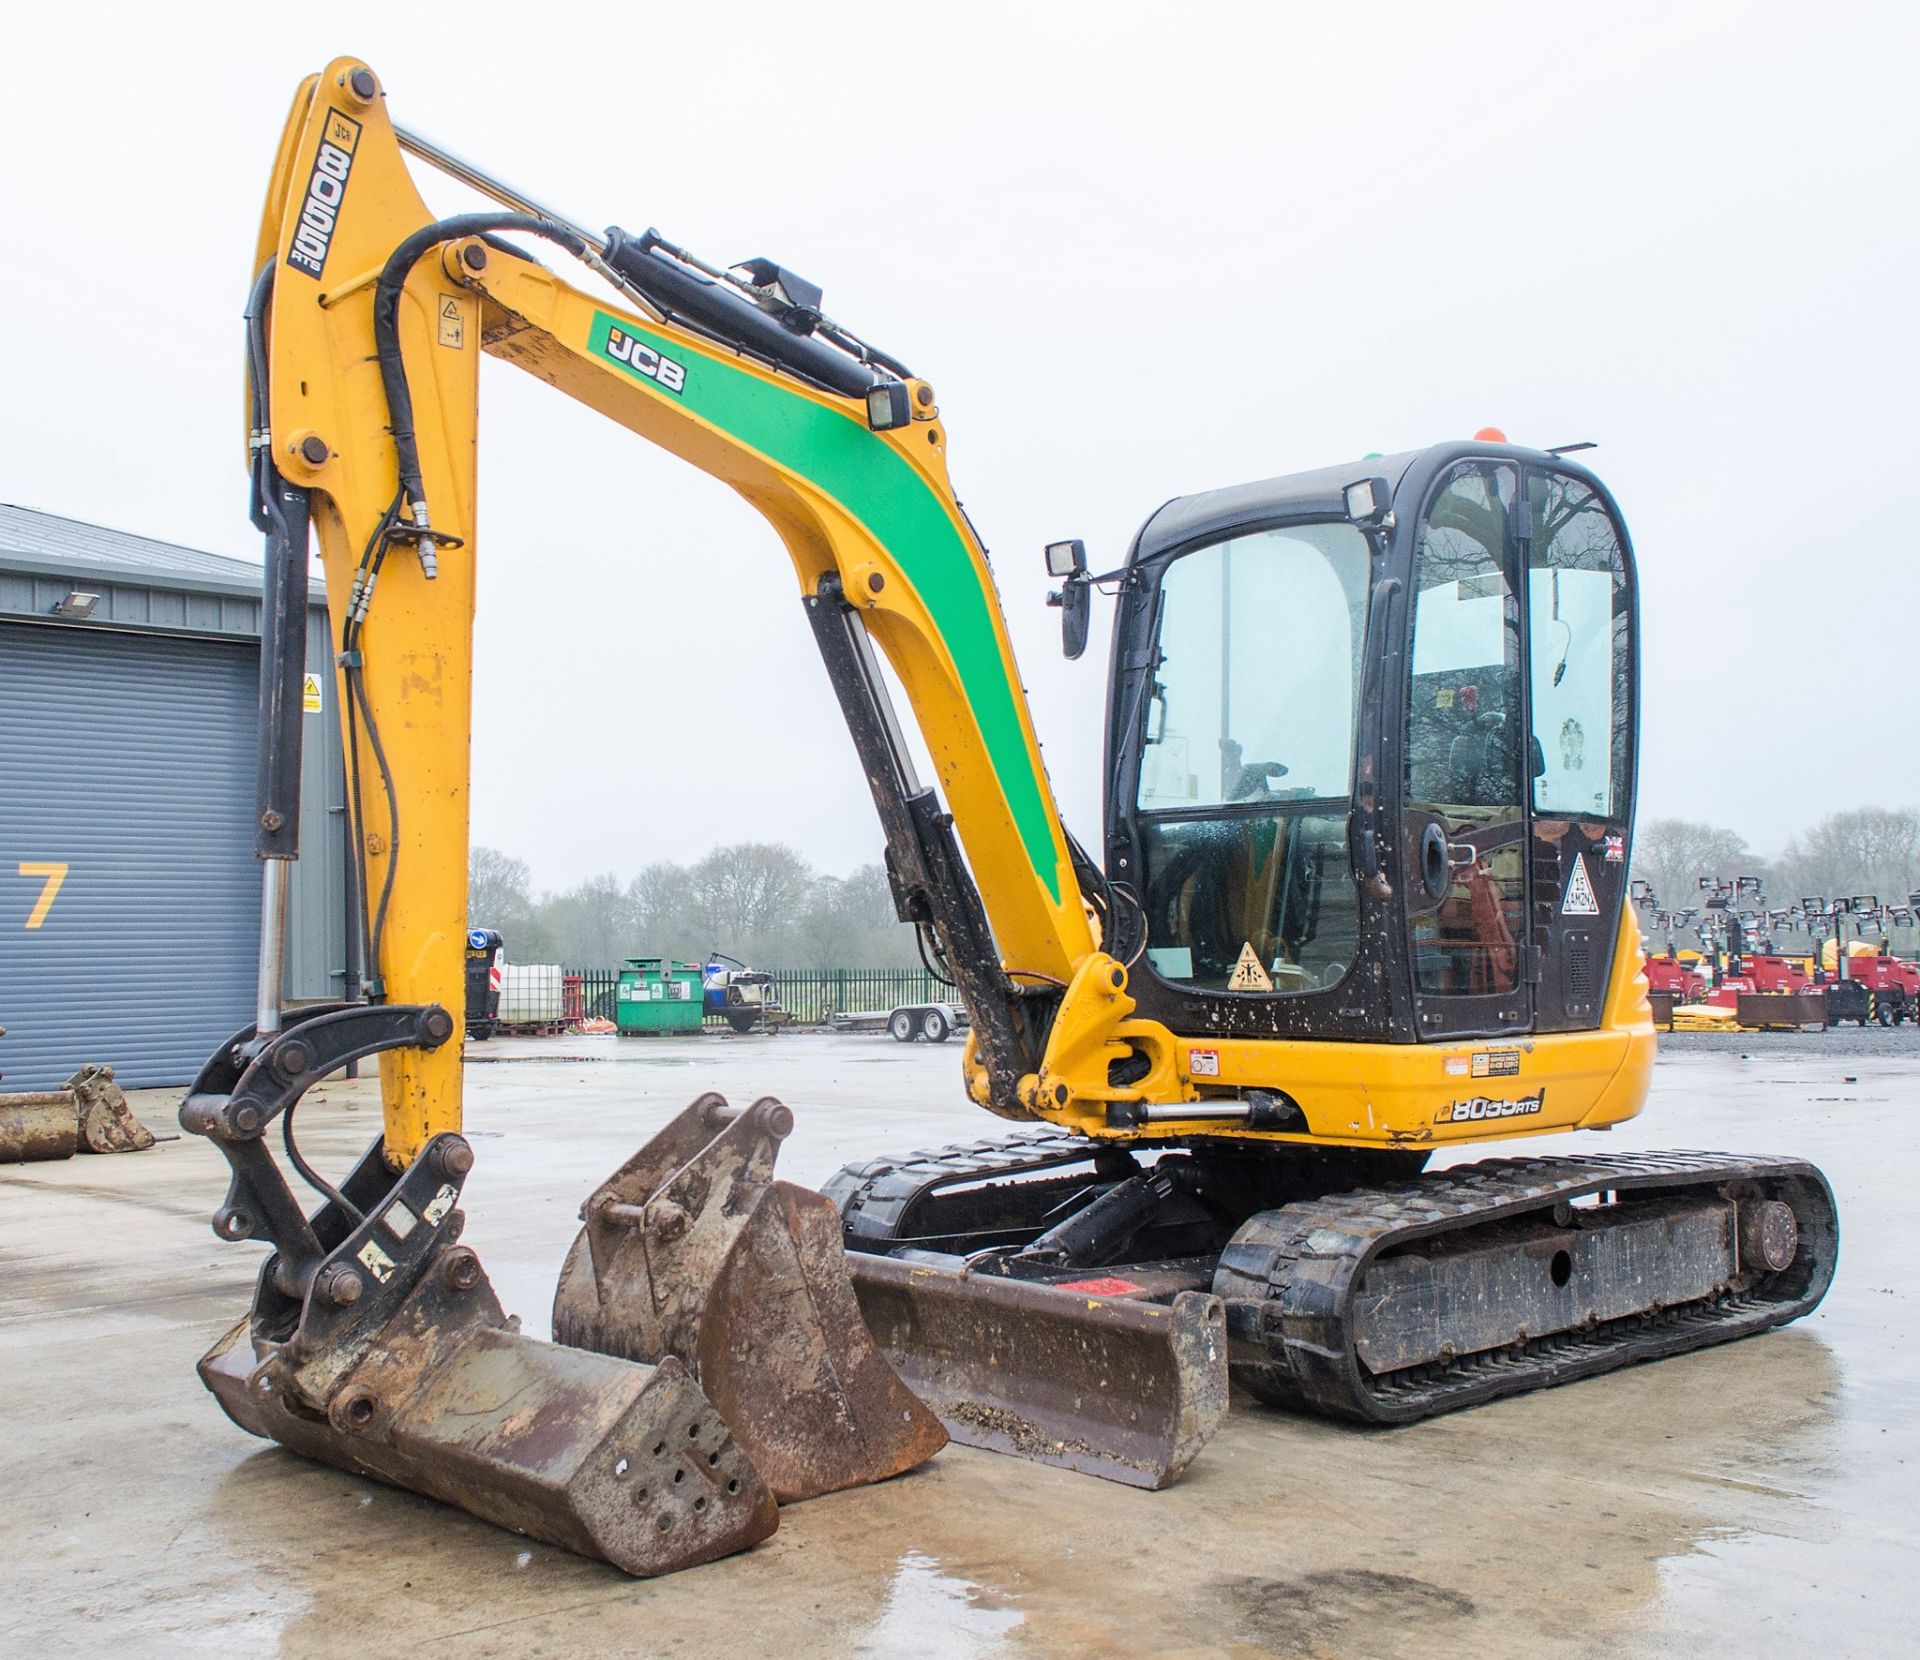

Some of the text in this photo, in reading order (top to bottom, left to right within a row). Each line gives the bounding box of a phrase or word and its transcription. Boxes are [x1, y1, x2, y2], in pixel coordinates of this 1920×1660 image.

[295, 143, 351, 261] 8055
[291, 250, 322, 272] RTS
[608, 329, 685, 391] JCB
[18, 863, 69, 929] 7
